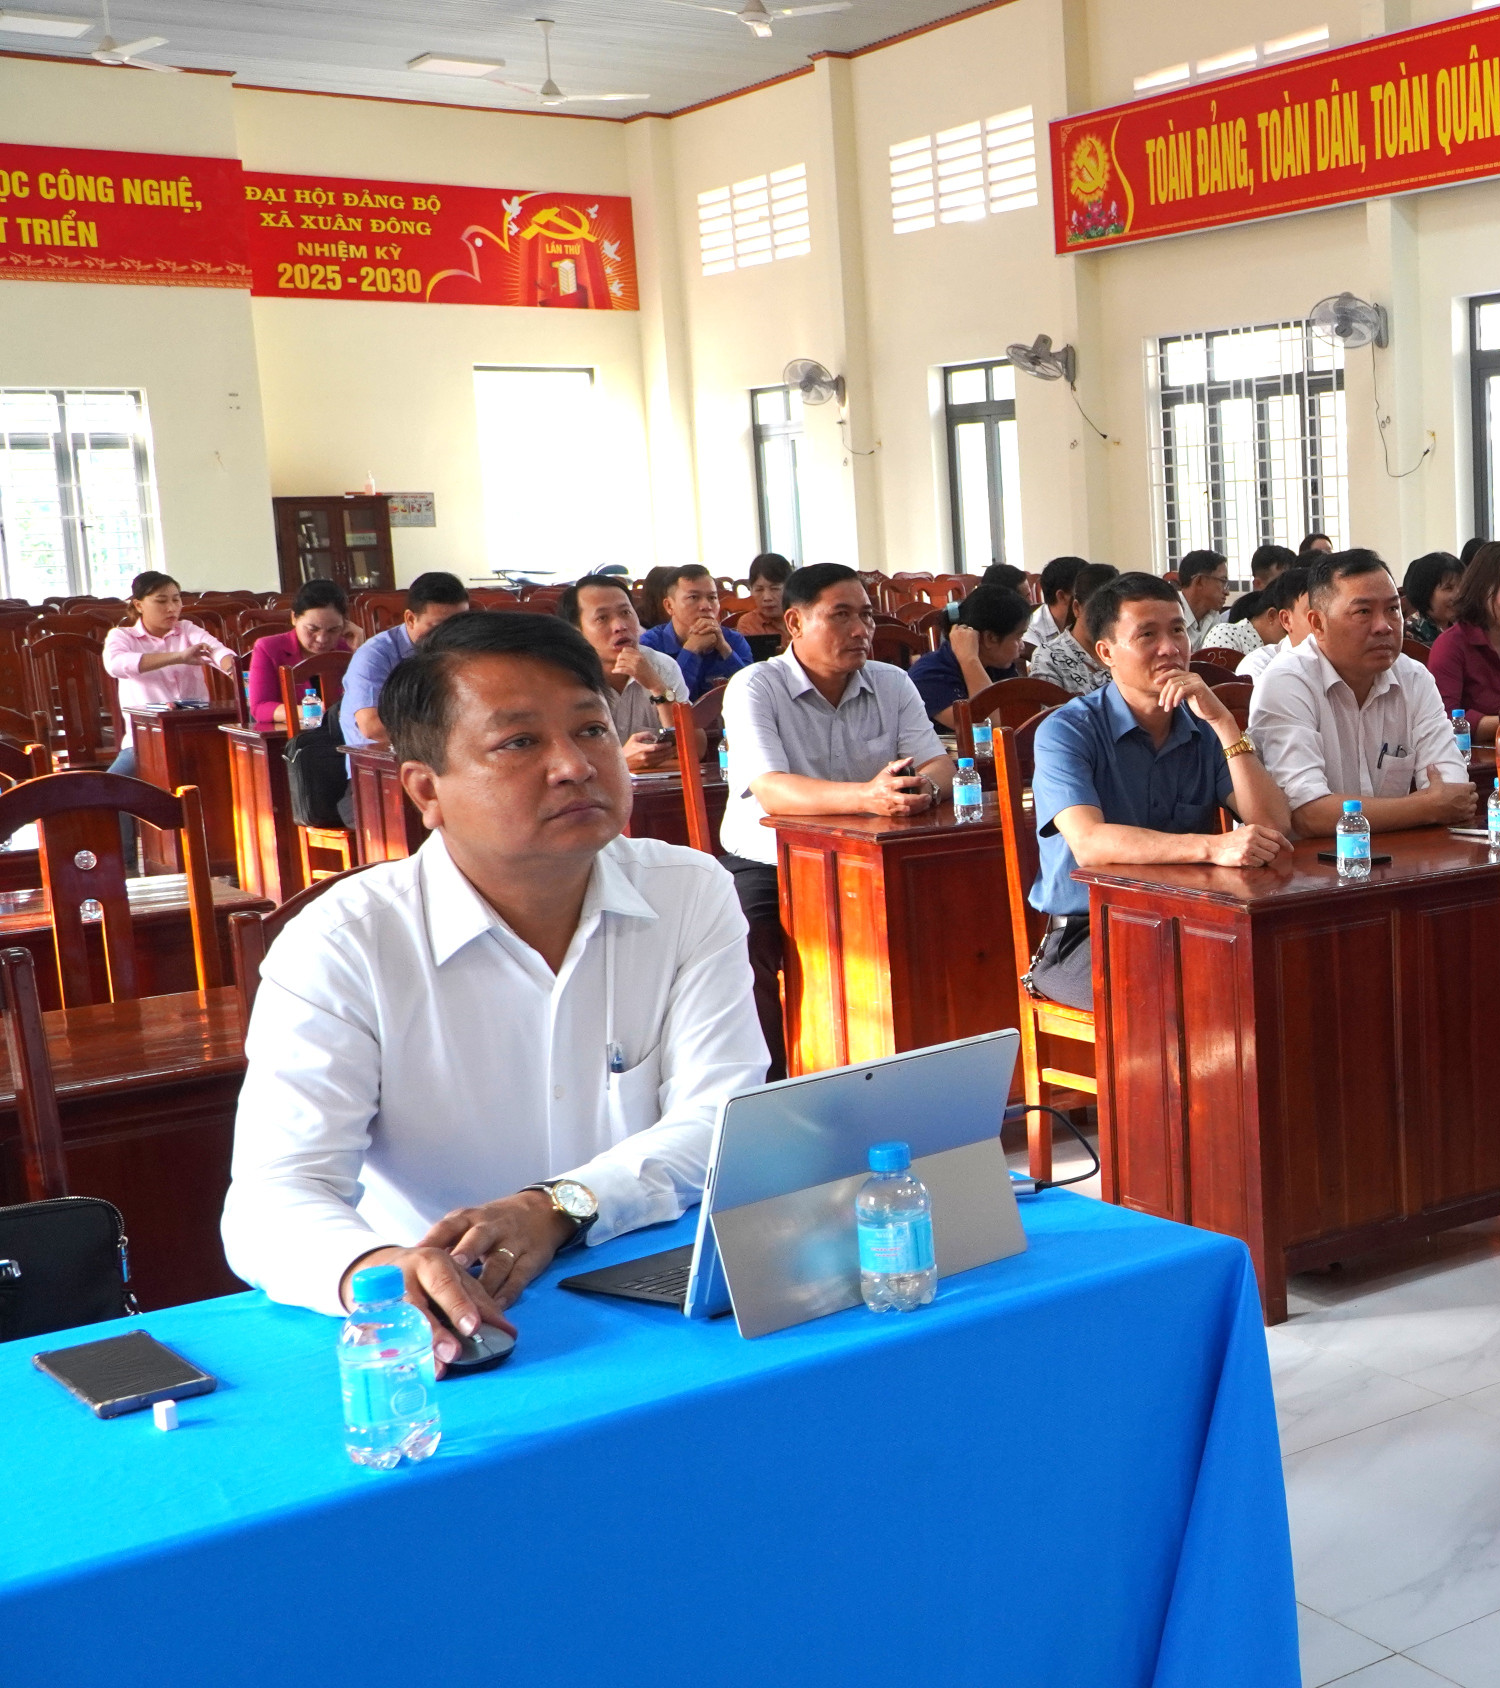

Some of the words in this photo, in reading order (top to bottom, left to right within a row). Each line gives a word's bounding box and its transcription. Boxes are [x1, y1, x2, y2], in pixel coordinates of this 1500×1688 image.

[1146, 119, 1193, 206] TOÀN
[1196, 100, 1254, 195] ĐẢNG,
[1257, 91, 1311, 183] TOÀN
[1315, 78, 1366, 173] DÂN,
[1370, 62, 1430, 160] TOÀN
[38, 168, 115, 203] CÔNG
[122, 176, 202, 213] NGHỆ,
[244, 186, 287, 205] ĐẠI
[294, 187, 336, 208] HỘI
[342, 189, 405, 210] ĐẢNG
[412, 195, 441, 215] BỘ
[16, 209, 98, 248] TRIỂN
[259, 210, 295, 228] XÃ
[300, 213, 362, 231] XUÂN
[370, 217, 432, 235] ĐÔNG
[297, 240, 368, 261] NHIỆM
[375, 243, 402, 261] KỲ
[277, 263, 342, 291] 2025
[360, 266, 422, 294] 2030
[1207, 650, 1228, 667] 25
